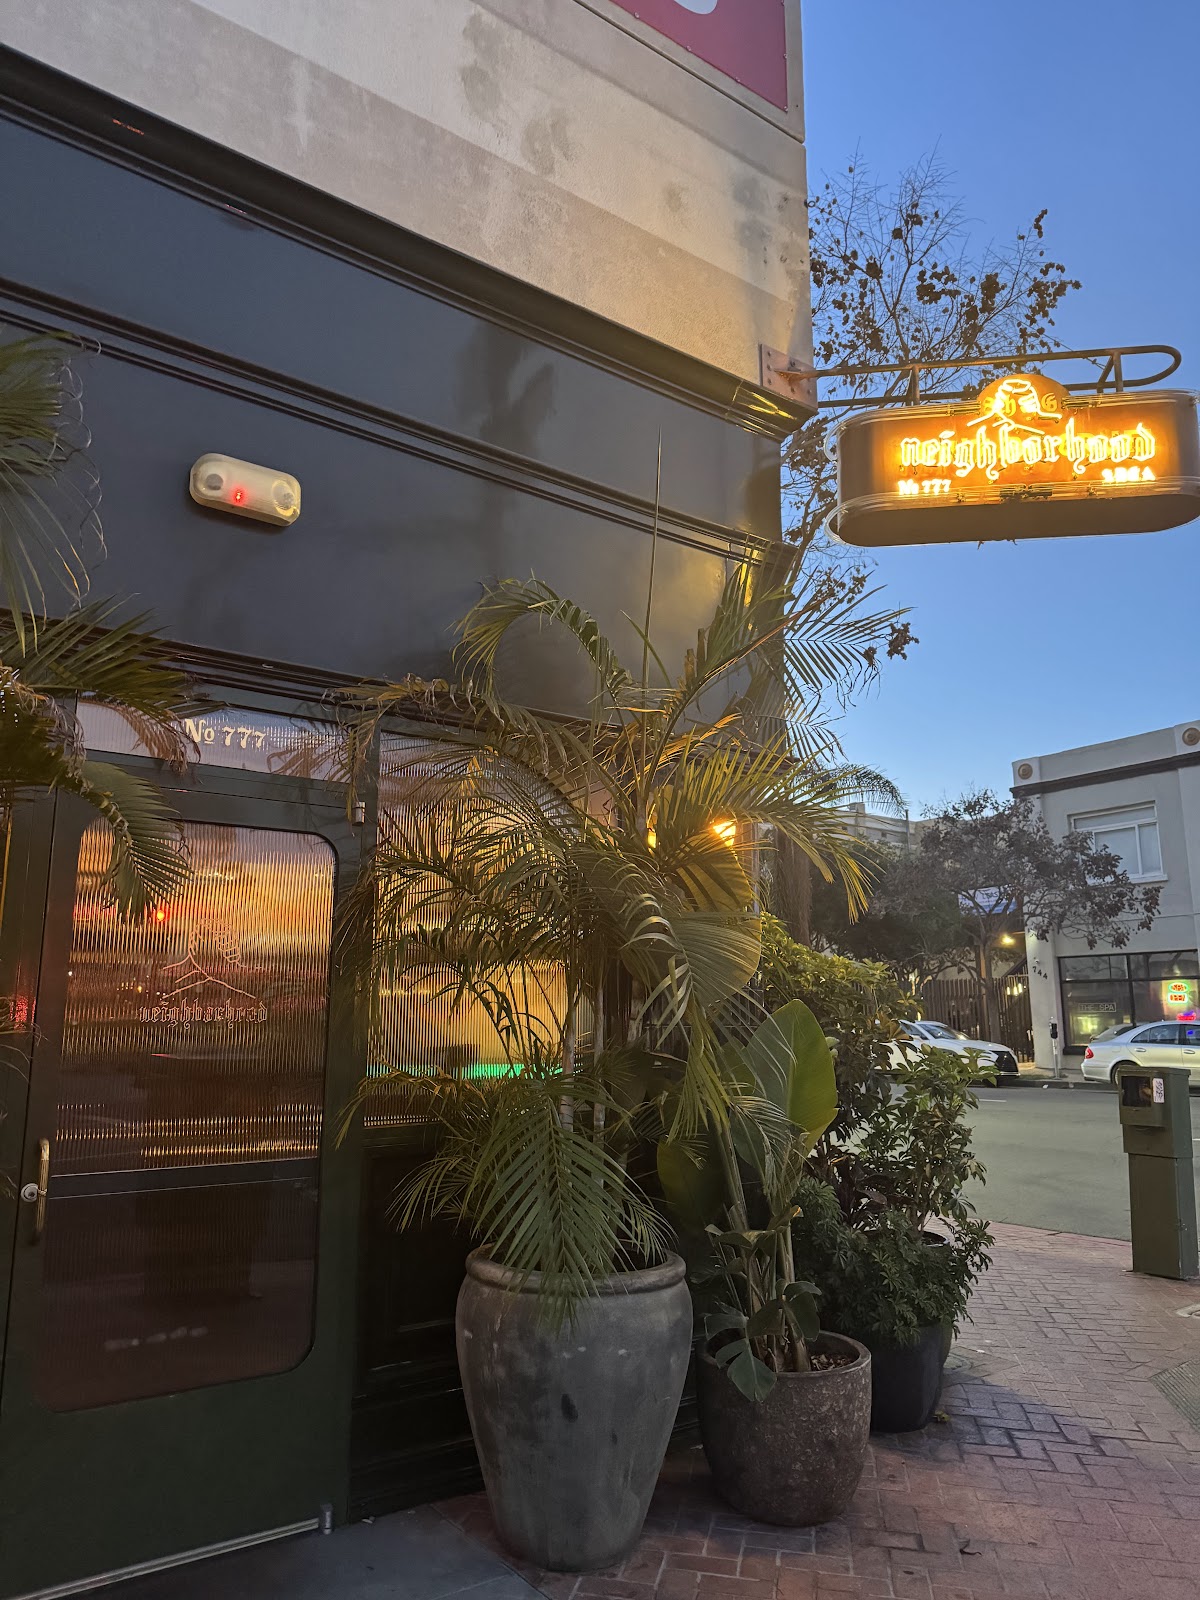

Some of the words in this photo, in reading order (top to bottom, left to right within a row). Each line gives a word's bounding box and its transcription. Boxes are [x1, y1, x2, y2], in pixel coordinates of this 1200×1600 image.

[899, 416, 1156, 480] neighborhood
[921, 478, 952, 497] 777
[222, 725, 267, 749] 777
[1032, 966, 1048, 980] 744
[1099, 1003, 1116, 1012] SPA
